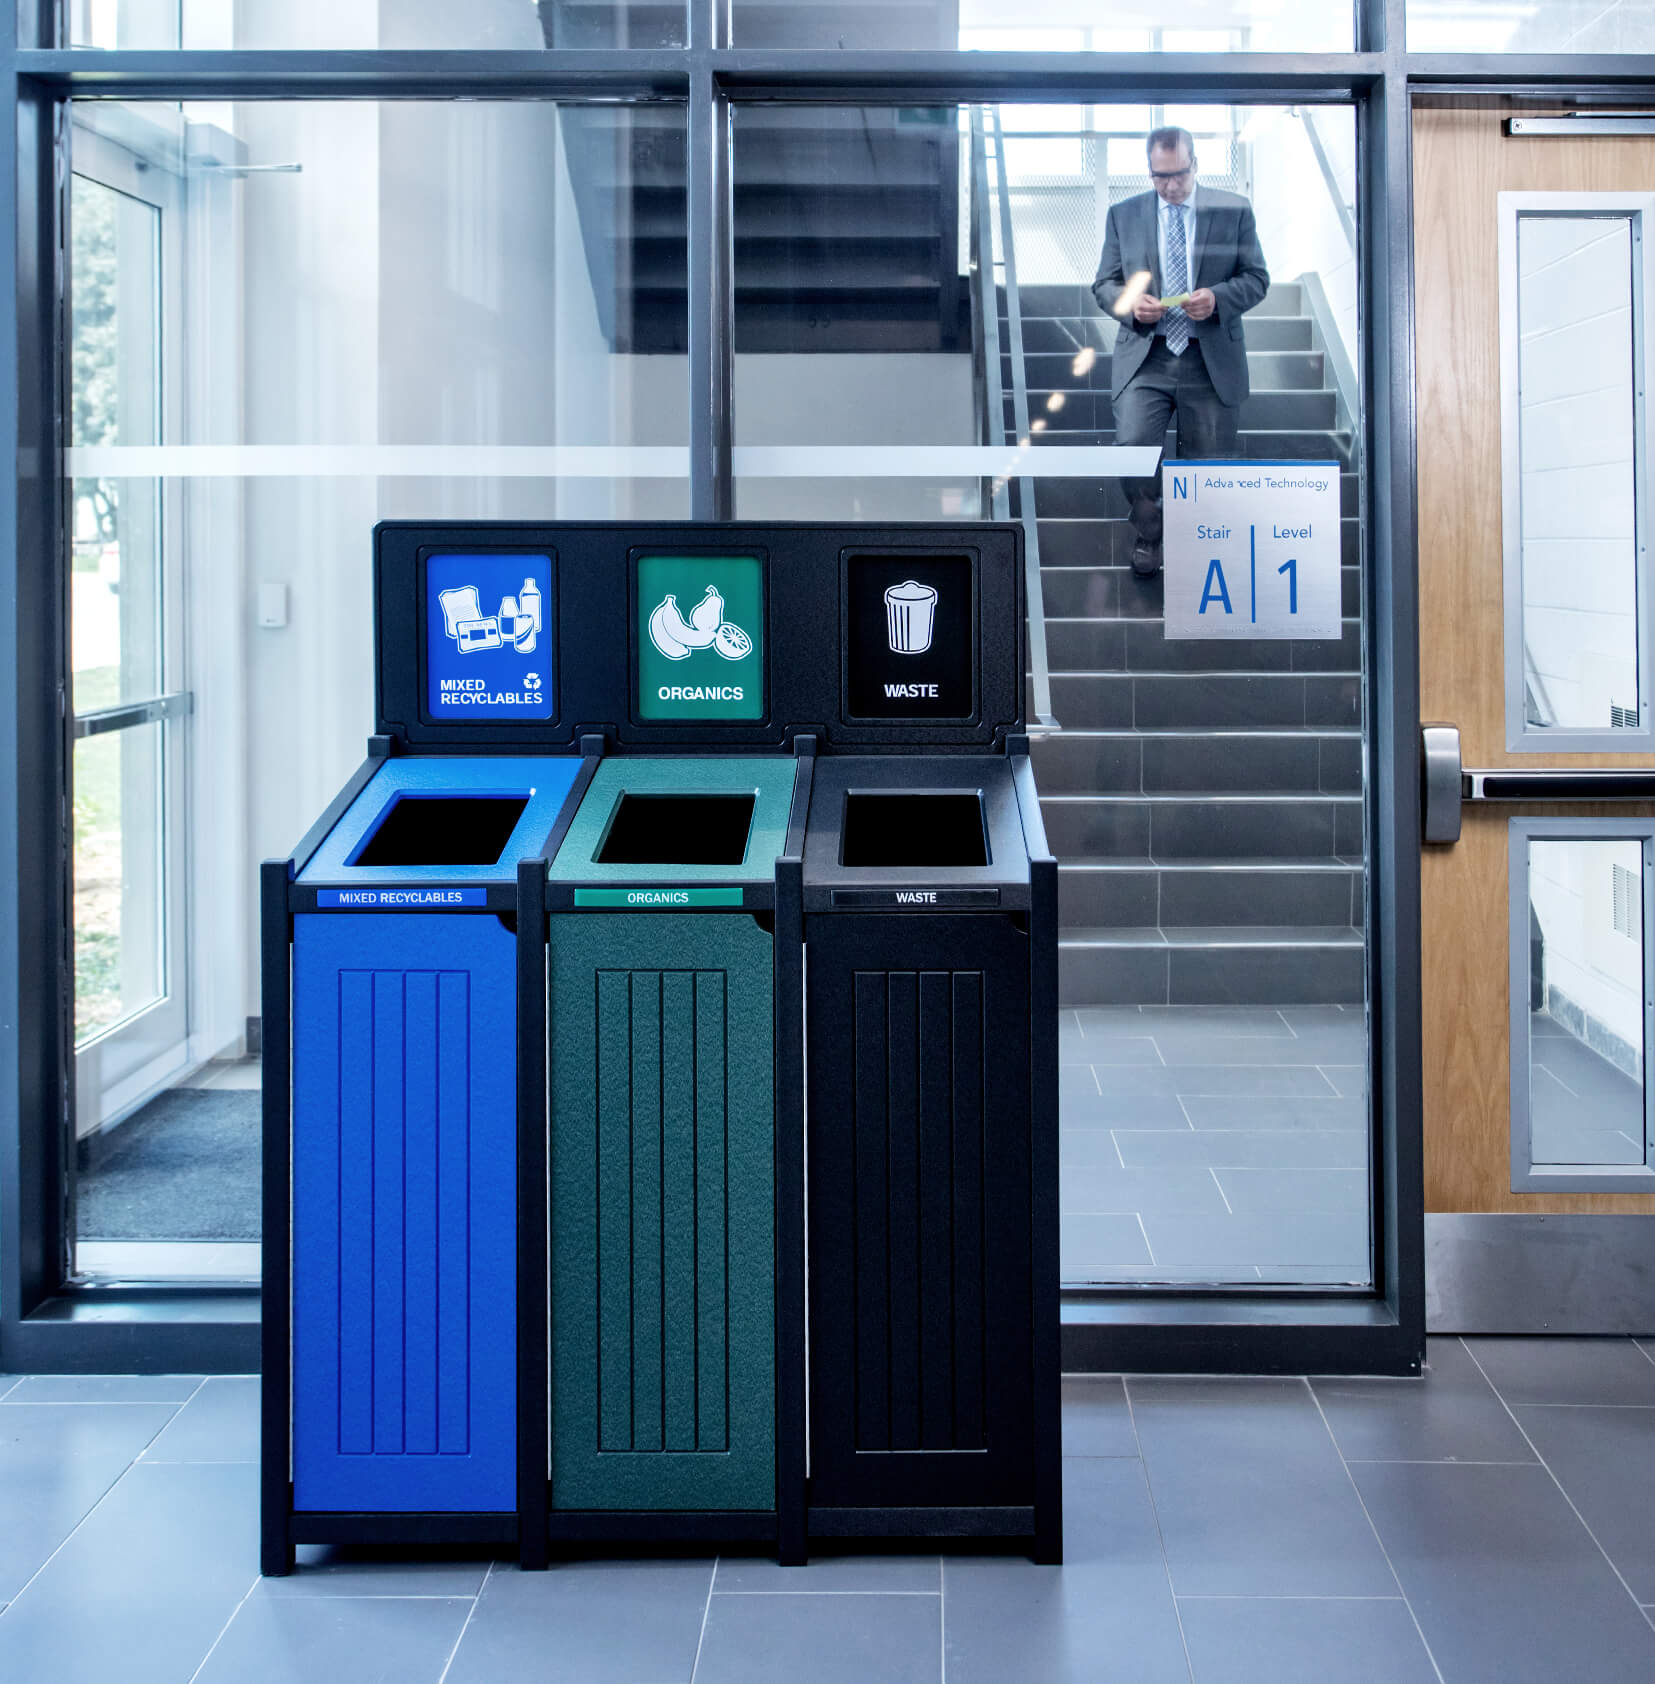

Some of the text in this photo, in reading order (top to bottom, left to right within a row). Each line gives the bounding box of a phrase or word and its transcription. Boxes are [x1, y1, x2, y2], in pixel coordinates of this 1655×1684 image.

[1173, 476, 1188, 500] N
[1204, 477, 1329, 492] Advaced Technology
[1197, 524, 1232, 539] Stair
[1273, 524, 1312, 539] Level
[1198, 559, 1233, 615] A
[1277, 559, 1298, 615] 1
[440, 679, 486, 691] MIXED
[884, 683, 939, 698] WASTE
[440, 692, 543, 705] RECYCLABLES
[658, 686, 744, 701] ORGANICS
[339, 891, 463, 904] MIXED RECYCLABLES
[627, 892, 689, 904] ORGANICS
[895, 892, 937, 904] WASTE
